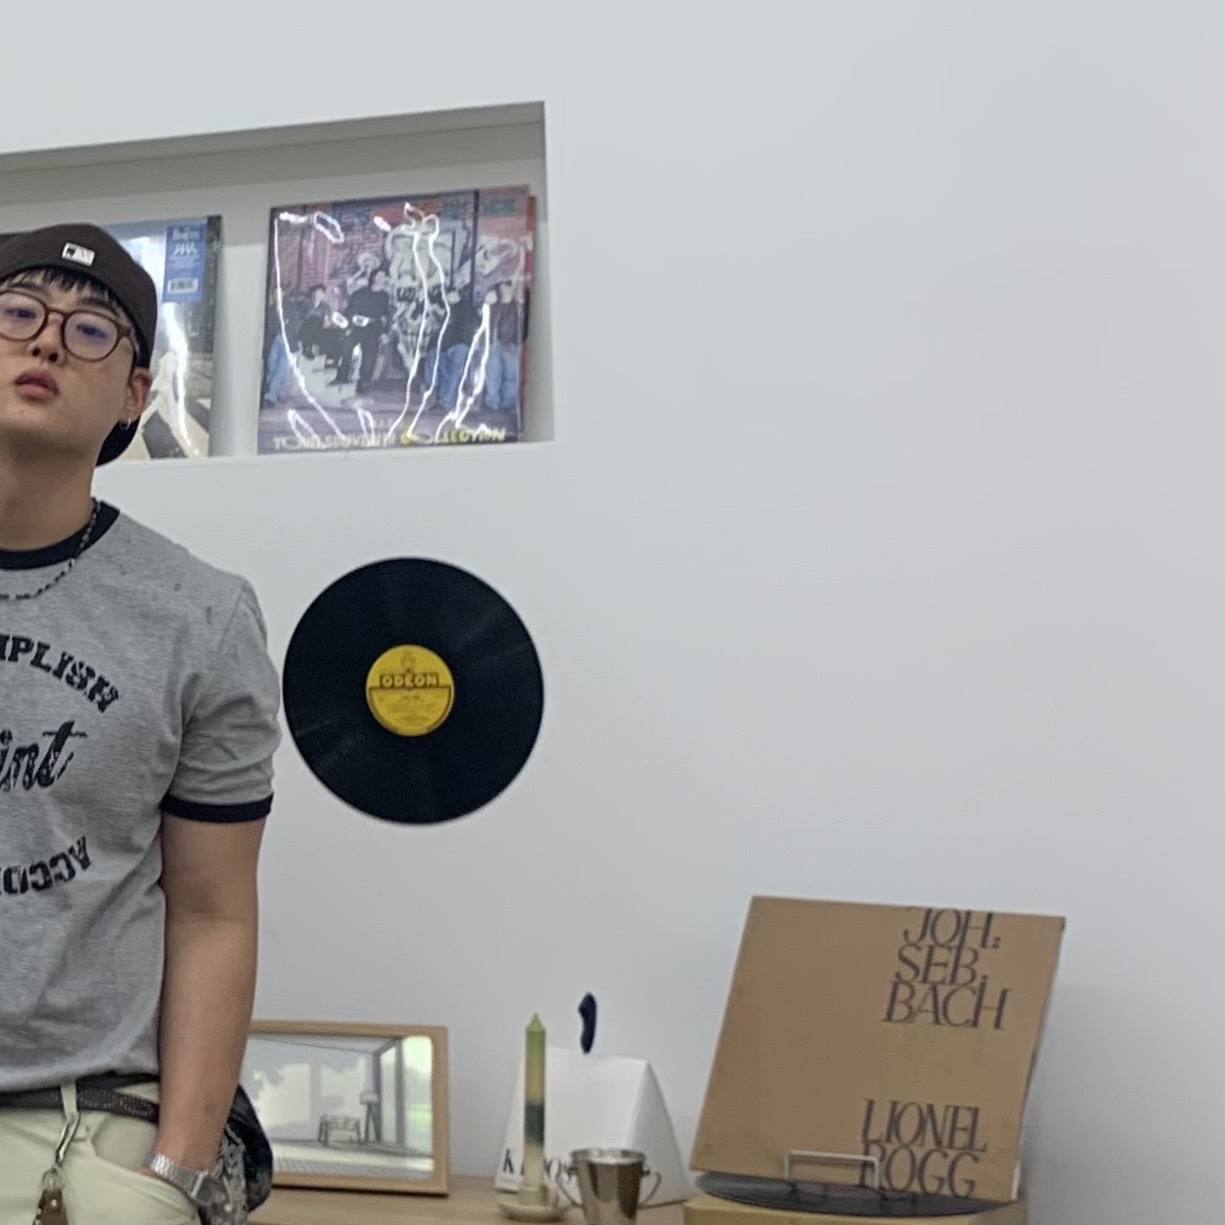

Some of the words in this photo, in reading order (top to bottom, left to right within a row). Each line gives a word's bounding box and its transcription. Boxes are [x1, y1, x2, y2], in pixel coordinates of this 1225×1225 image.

[379, 672, 439, 688] ODEON
[881, 980, 1013, 1030] BACH
[862, 1099, 988, 1152] LIONEL
